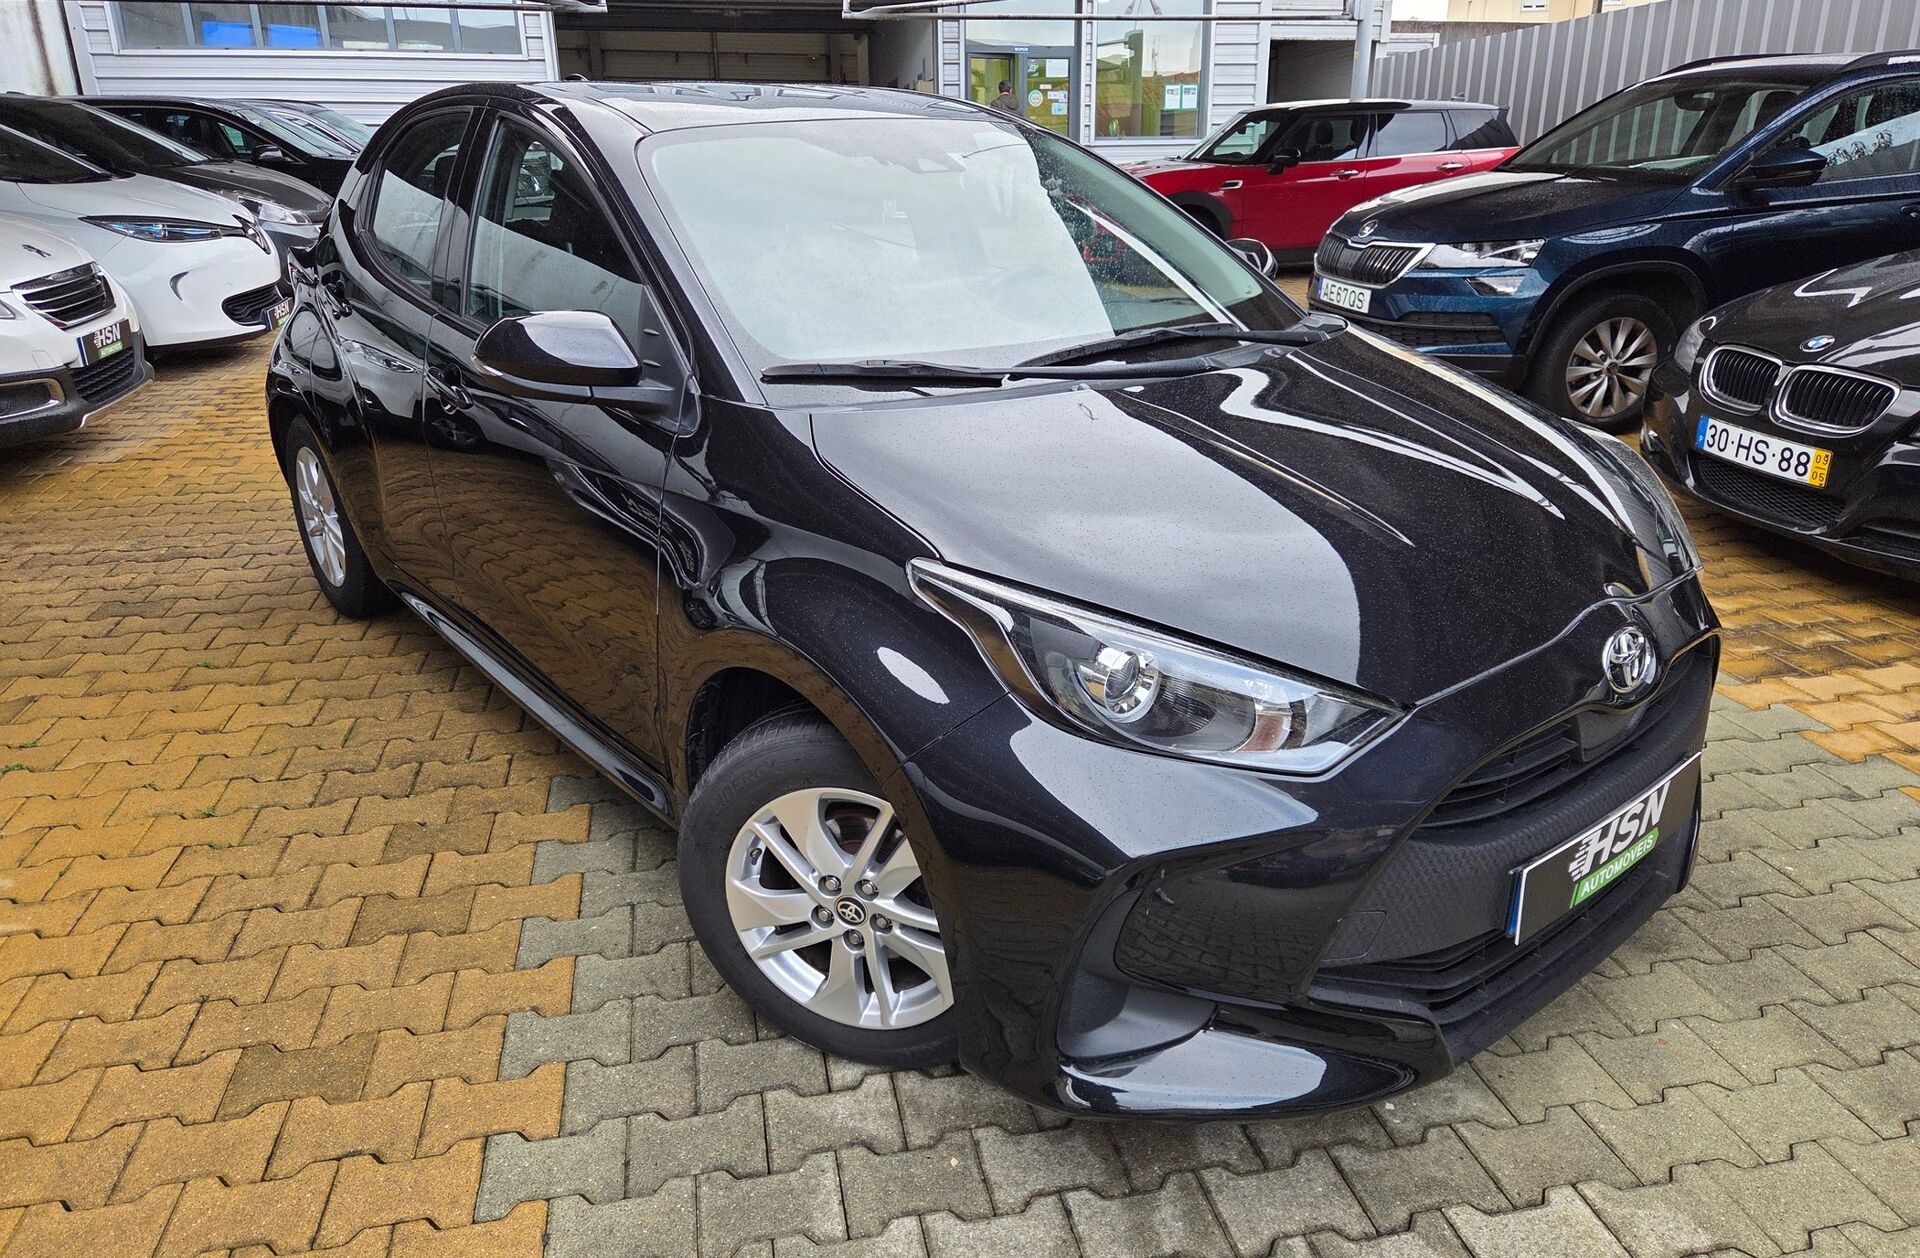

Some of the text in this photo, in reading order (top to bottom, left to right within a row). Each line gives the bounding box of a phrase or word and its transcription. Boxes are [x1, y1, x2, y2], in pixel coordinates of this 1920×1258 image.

[274, 300, 290, 320] HSN
[1322, 282, 1365, 310] AE67QS
[93, 323, 121, 348] HSN
[1568, 780, 1672, 882] HSN
[1580, 834, 1654, 897] AUTOMOVEIS
